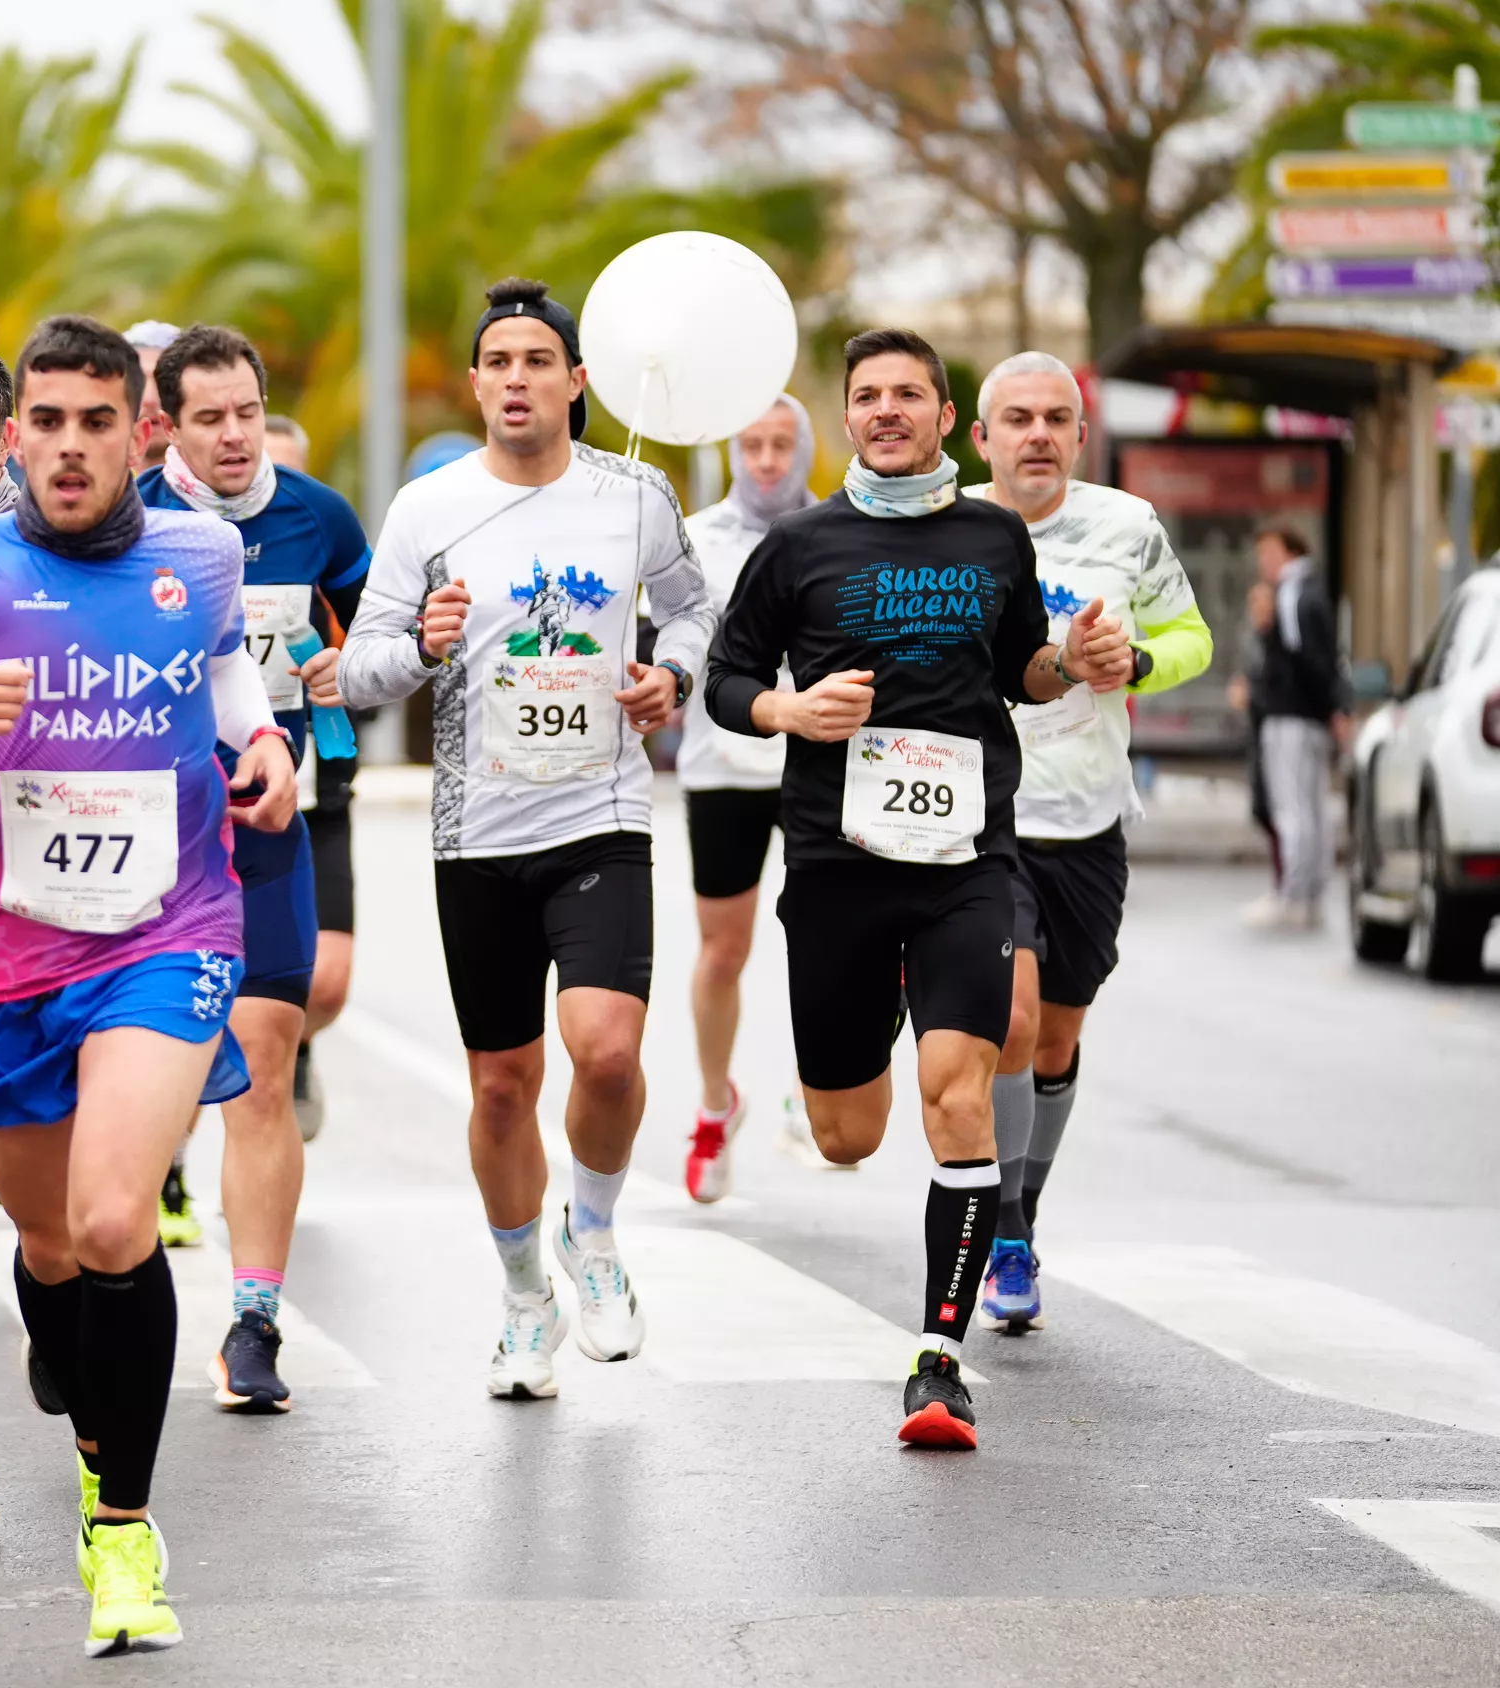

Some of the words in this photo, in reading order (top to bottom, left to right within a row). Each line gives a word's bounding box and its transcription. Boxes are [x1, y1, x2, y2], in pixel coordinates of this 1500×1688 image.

[876, 566, 978, 594] SURCO
[873, 594, 983, 621] LUCENA
[900, 620, 965, 635] atletismo
[0, 642, 206, 701] ILÍPIDES
[30, 704, 173, 740] PARADAS
[518, 704, 588, 736] 394
[905, 752, 945, 770] LUCENA
[883, 778, 954, 818] 289
[43, 833, 134, 874] 477
[947, 1196, 979, 1299] COMPRESSPORT
